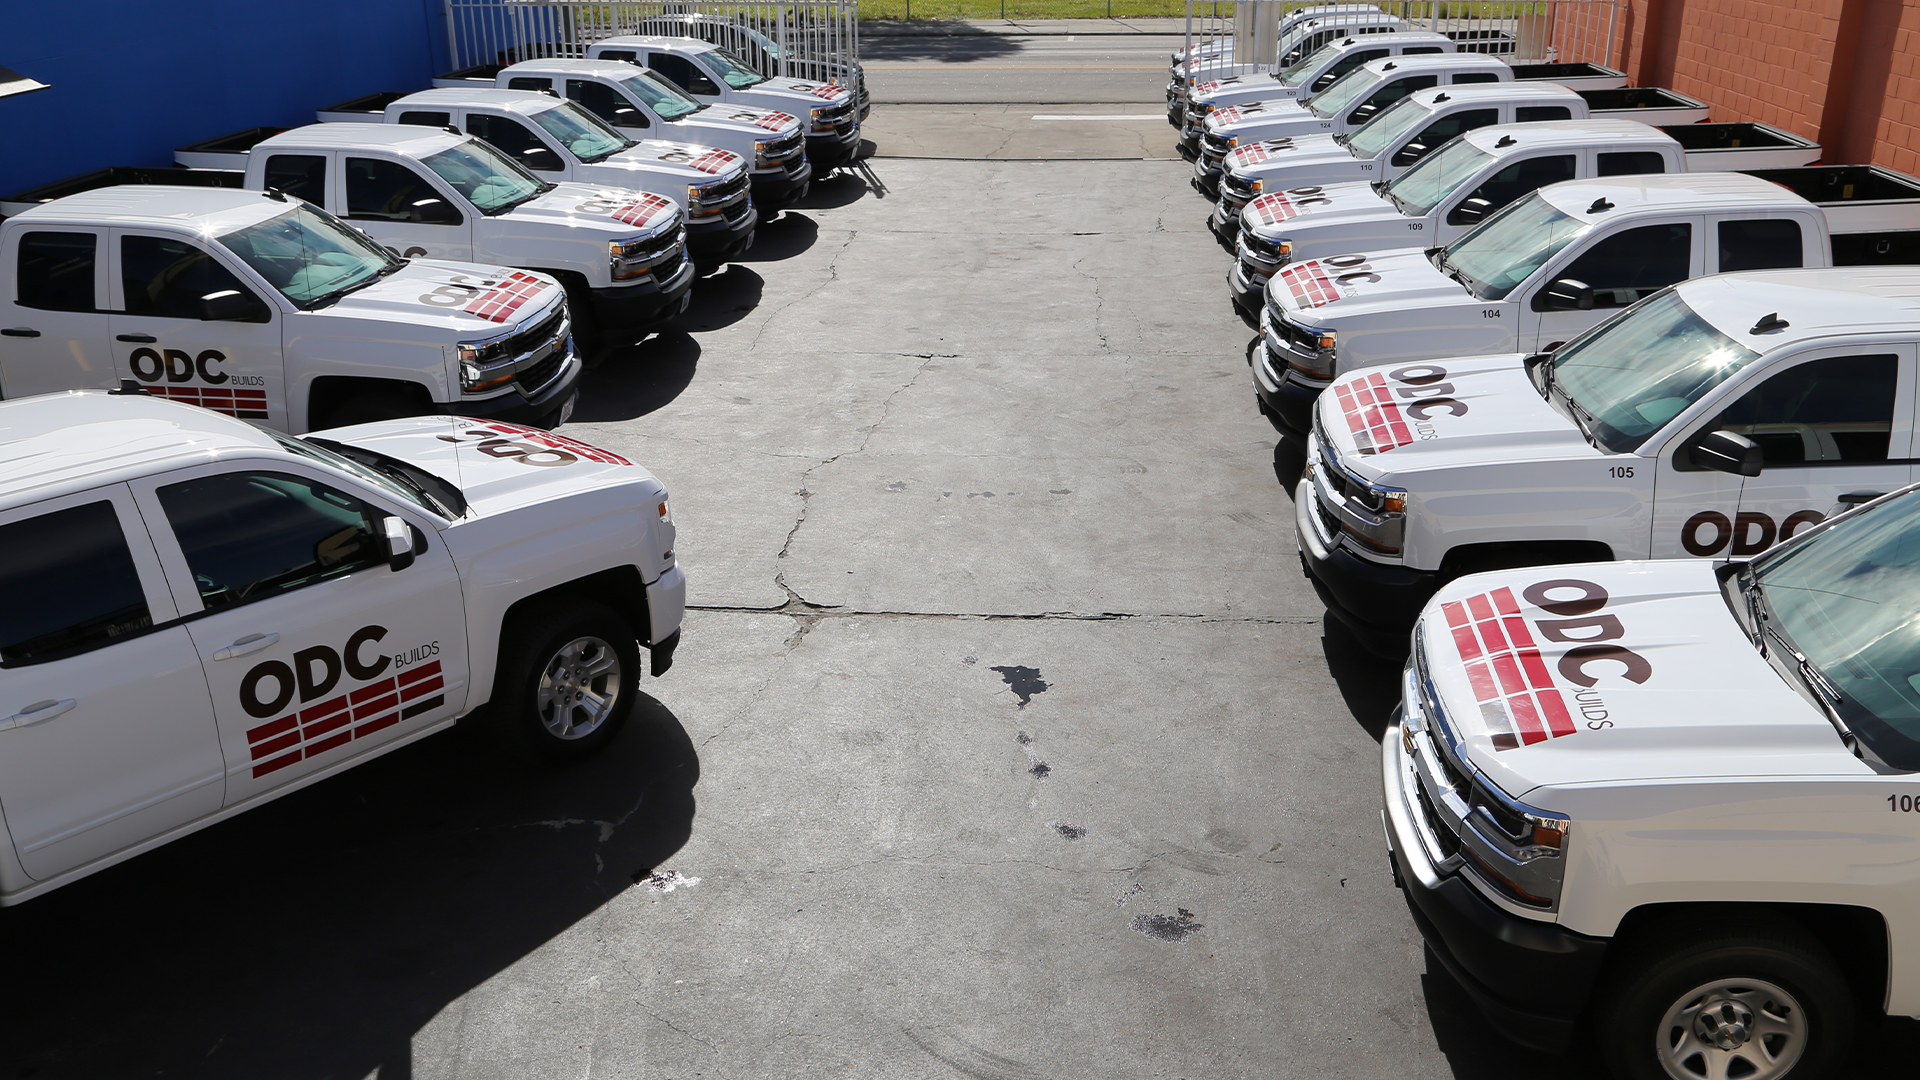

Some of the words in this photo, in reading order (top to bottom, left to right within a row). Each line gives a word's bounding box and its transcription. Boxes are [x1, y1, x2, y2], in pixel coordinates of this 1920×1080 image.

[1407, 223, 1423, 231] 109
[1481, 309, 1501, 319] 104
[129, 347, 229, 385] ODC
[231, 375, 265, 387] BUILDS
[1389, 365, 1468, 420] ODC
[1608, 466, 1634, 478] 105
[1522, 579, 1652, 688] ODC
[239, 624, 392, 719] ODC
[394, 640, 440, 669] BUILDS
[1887, 794, 1920, 813] 106
